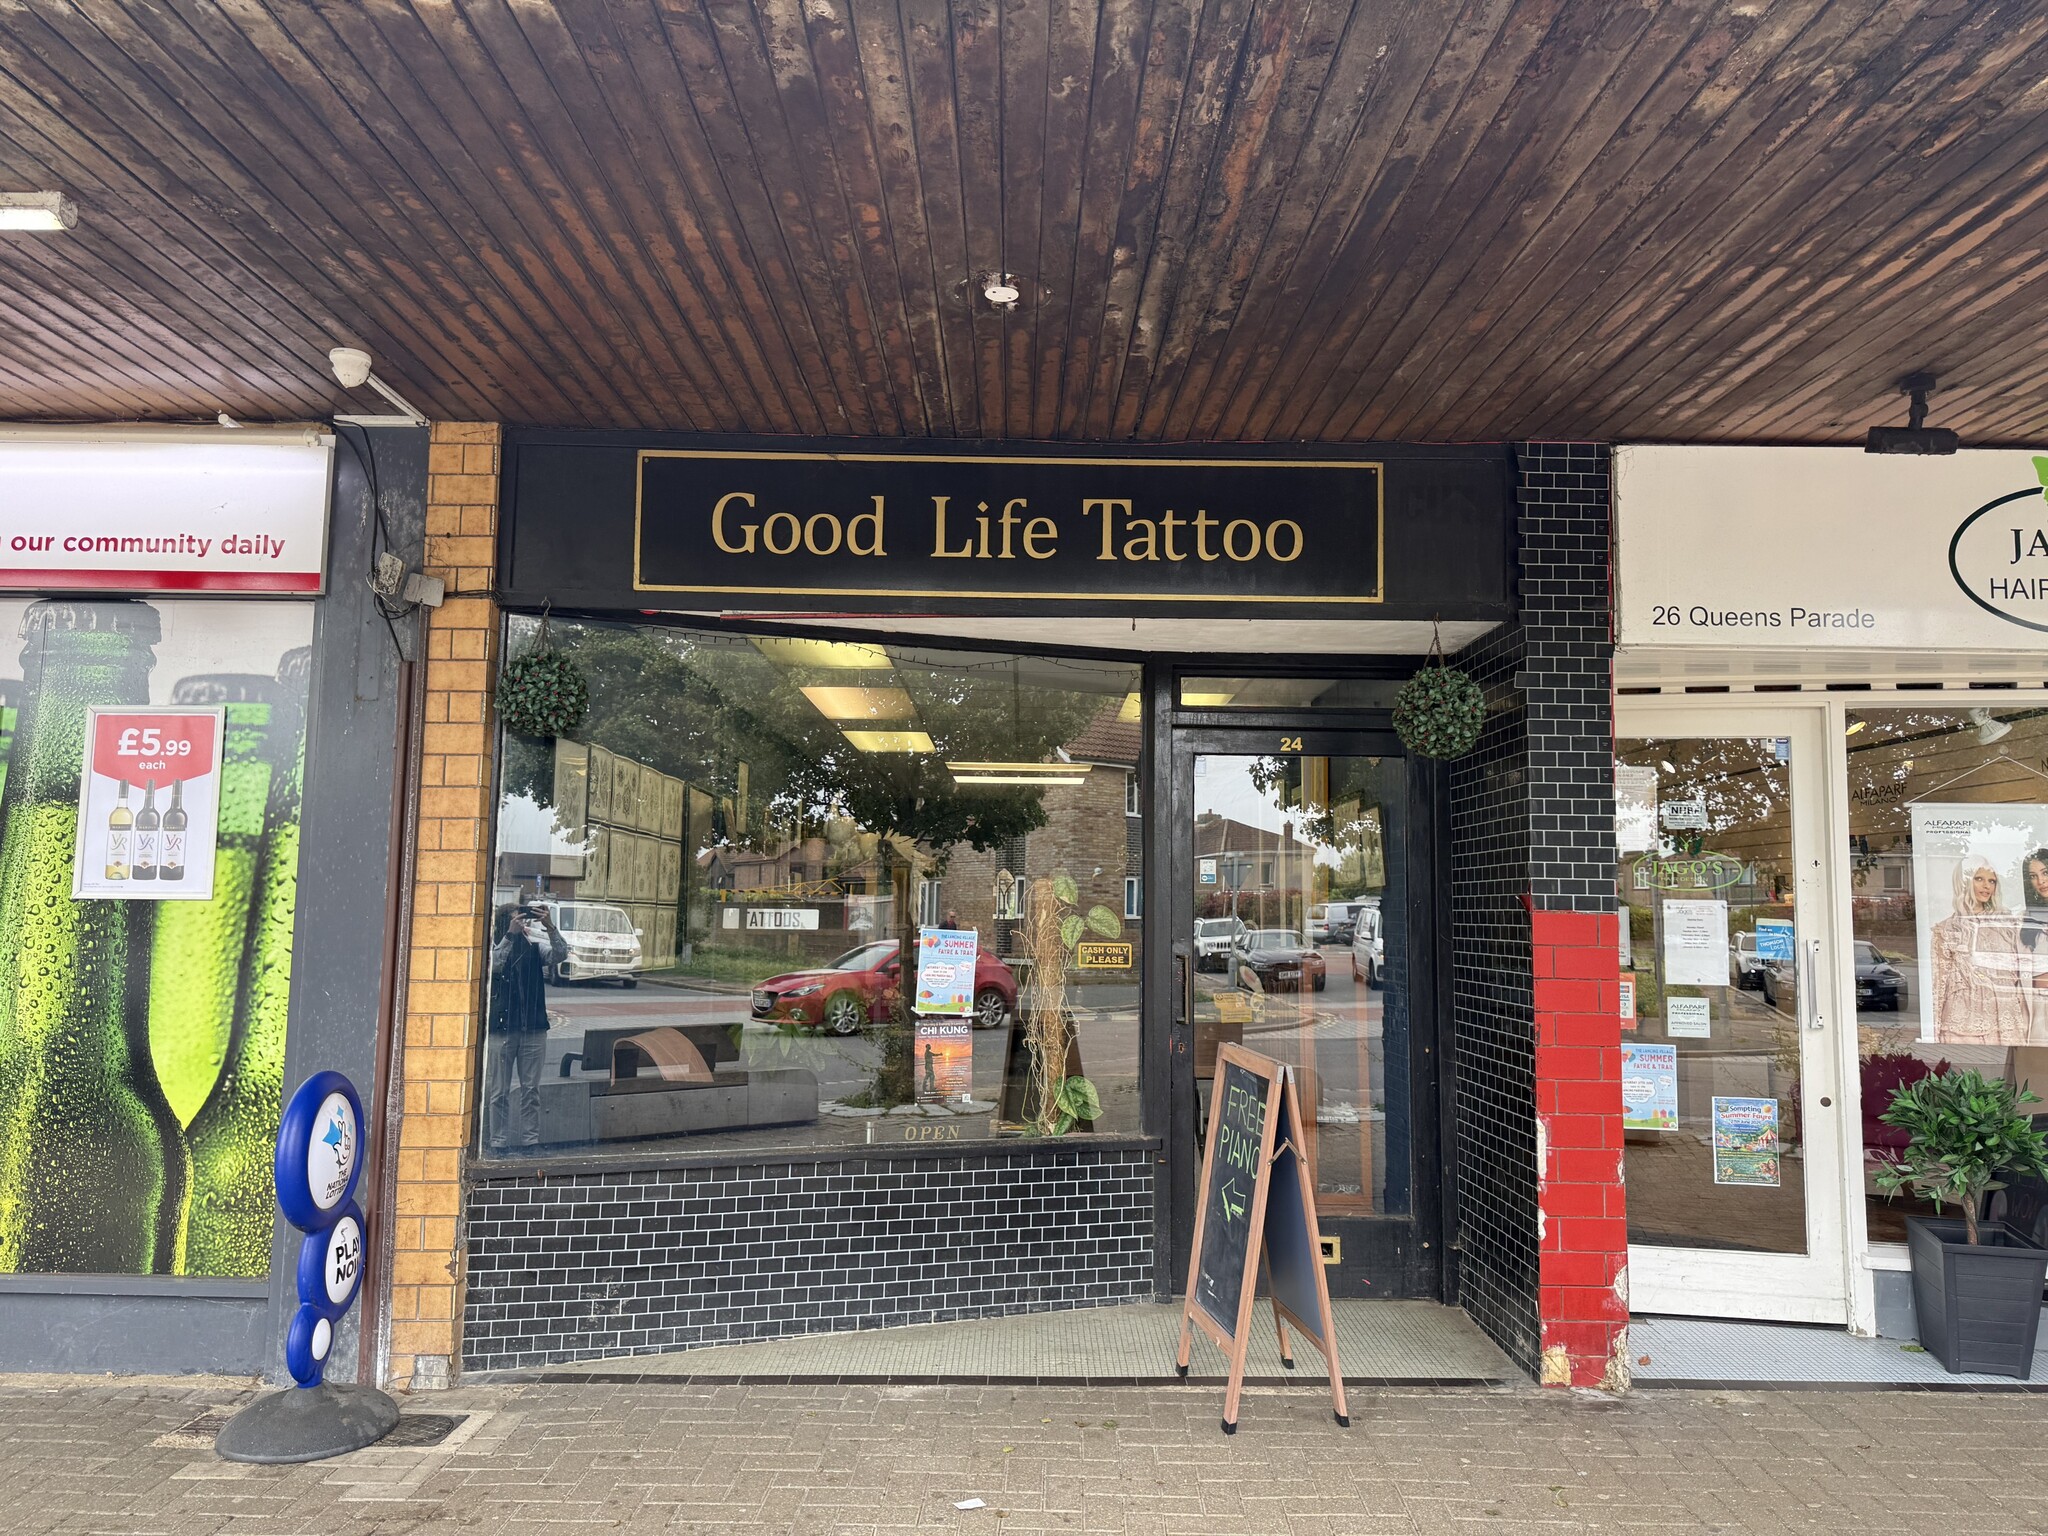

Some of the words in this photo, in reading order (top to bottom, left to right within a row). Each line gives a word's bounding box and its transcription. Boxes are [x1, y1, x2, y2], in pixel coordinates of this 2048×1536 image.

[711, 492, 887, 556] Good
[930, 496, 1059, 559] Life
[1082, 498, 1304, 562] Tattoo
[10, 536, 55, 552] our
[63, 533, 212, 558] community
[220, 534, 286, 559] daily
[1652, 606, 1681, 626] 26
[1689, 606, 1782, 627] Queens
[1790, 607, 1875, 628] Parade
[117, 728, 192, 757] £5.99
[1280, 737, 1303, 752] 24
[138, 760, 166, 770] each
[1851, 782, 1908, 800] ALFAPARF
[1859, 796, 1899, 806] MILANO
[1651, 860, 1724, 877] JAGO'S
[944, 940, 974, 949] SUMMER
[1081, 946, 1105, 954] CASH
[1086, 956, 1125, 964] PLEASE
[920, 1026, 938, 1035] CHI
[940, 1025, 969, 1035] KUNG
[1640, 1054, 1674, 1063] SUMMER
[1227, 1085, 1266, 1137] FREE
[1729, 1105, 1762, 1113] Sompting
[904, 1124, 961, 1141] OPEN
[1219, 1124, 1261, 1180] PIANO
[338, 1168, 348, 1179] THE
[335, 1235, 360, 1264] PLAY
